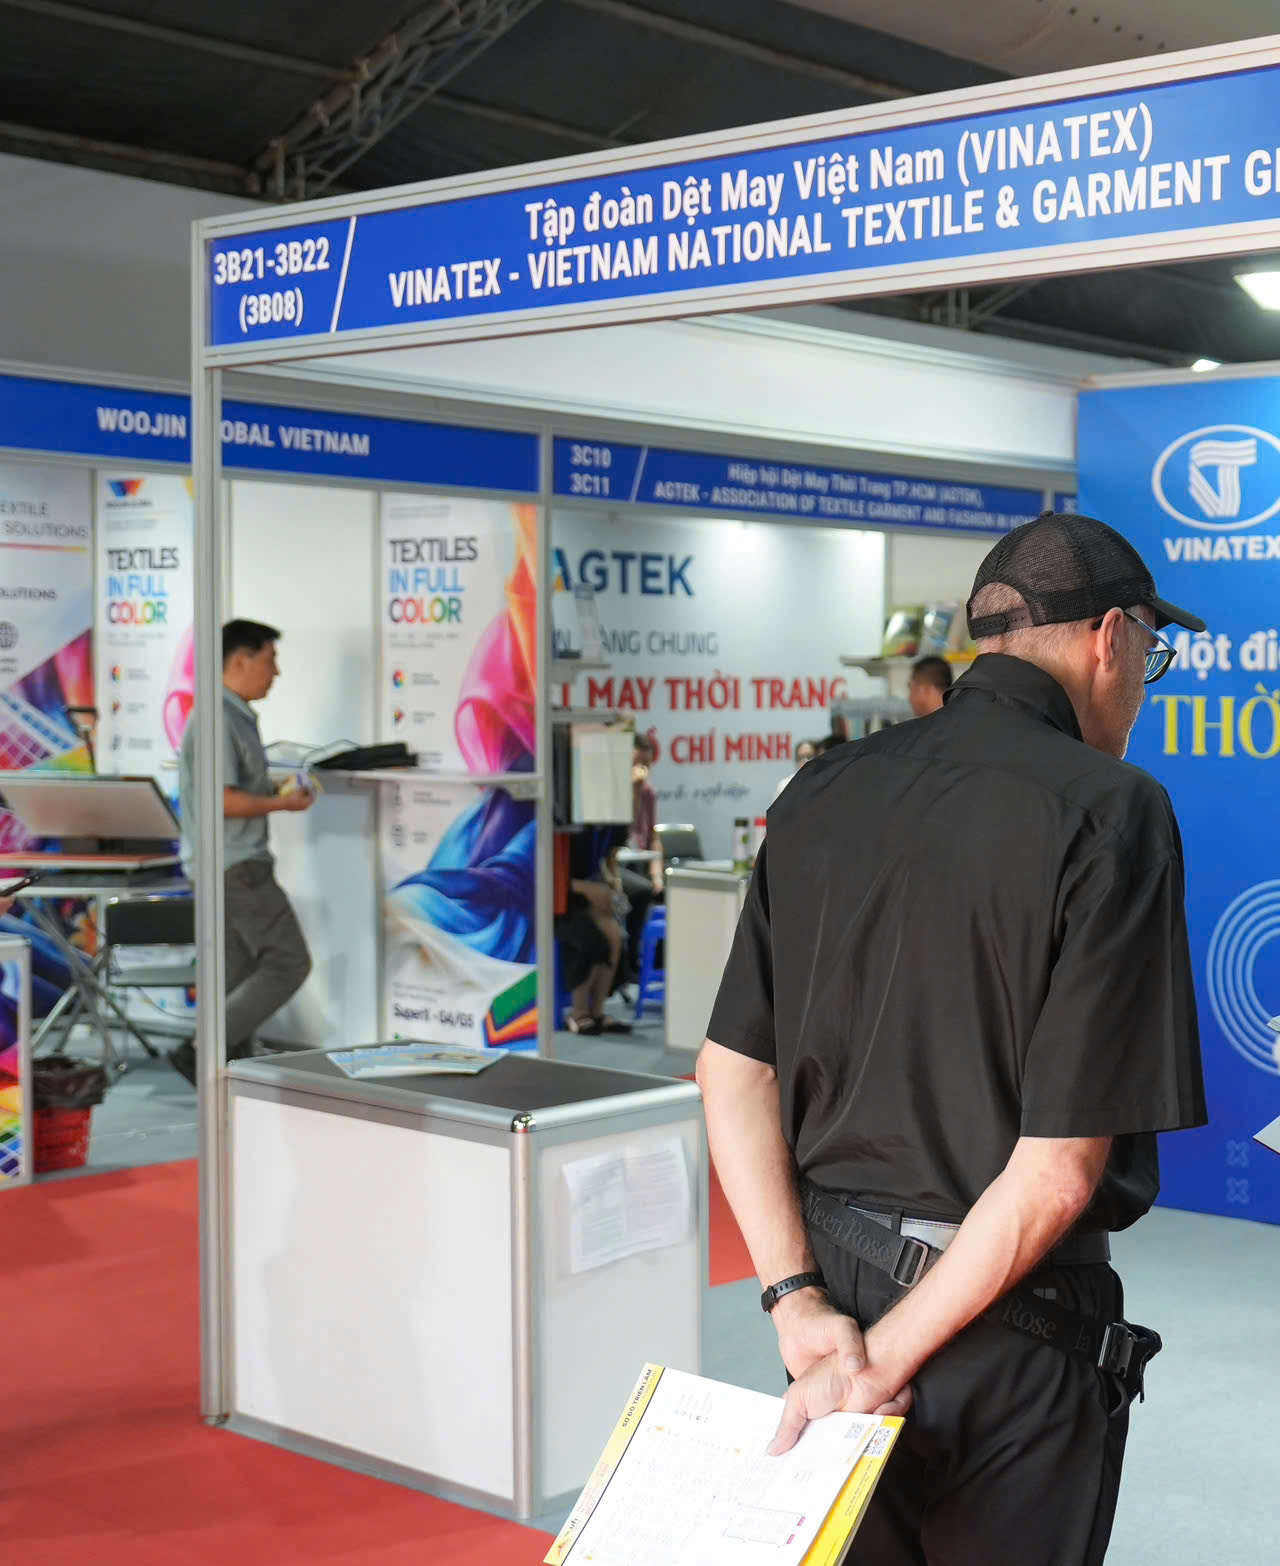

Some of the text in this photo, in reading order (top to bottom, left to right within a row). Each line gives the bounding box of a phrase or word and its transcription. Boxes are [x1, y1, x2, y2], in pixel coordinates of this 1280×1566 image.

[525, 102, 1154, 245] Tập đoàn Dệt May Việt Nam (VINATEX)
[389, 257, 501, 309] VINATEX
[528, 237, 658, 291] VIETNAM
[667, 211, 831, 272] NATIONAL
[841, 189, 985, 249] TEXTILE
[995, 185, 1021, 230] &
[1031, 154, 1231, 224] GARMENT
[213, 236, 331, 286] 3B21-3B22
[238, 288, 304, 333] (3B08)
[96, 406, 370, 456] WOOJIN OBAL VIETNAM
[569, 444, 613, 468] 3C10
[569, 472, 610, 496] 3C11
[654, 479, 701, 502] AGTEK
[4, 520, 89, 539] SOLUTIONS
[106, 547, 180, 571] TEXTILES
[388, 536, 479, 563] TEXTILES
[106, 574, 169, 598] IN FULL
[389, 567, 466, 593] IN FULL
[107, 600, 169, 625] COLOR
[388, 596, 463, 624] COLOR
[645, 629, 719, 656] CHUNG
[586, 674, 655, 711] MAY
[669, 726, 717, 765] CHÍ
[723, 730, 793, 763] MINH
